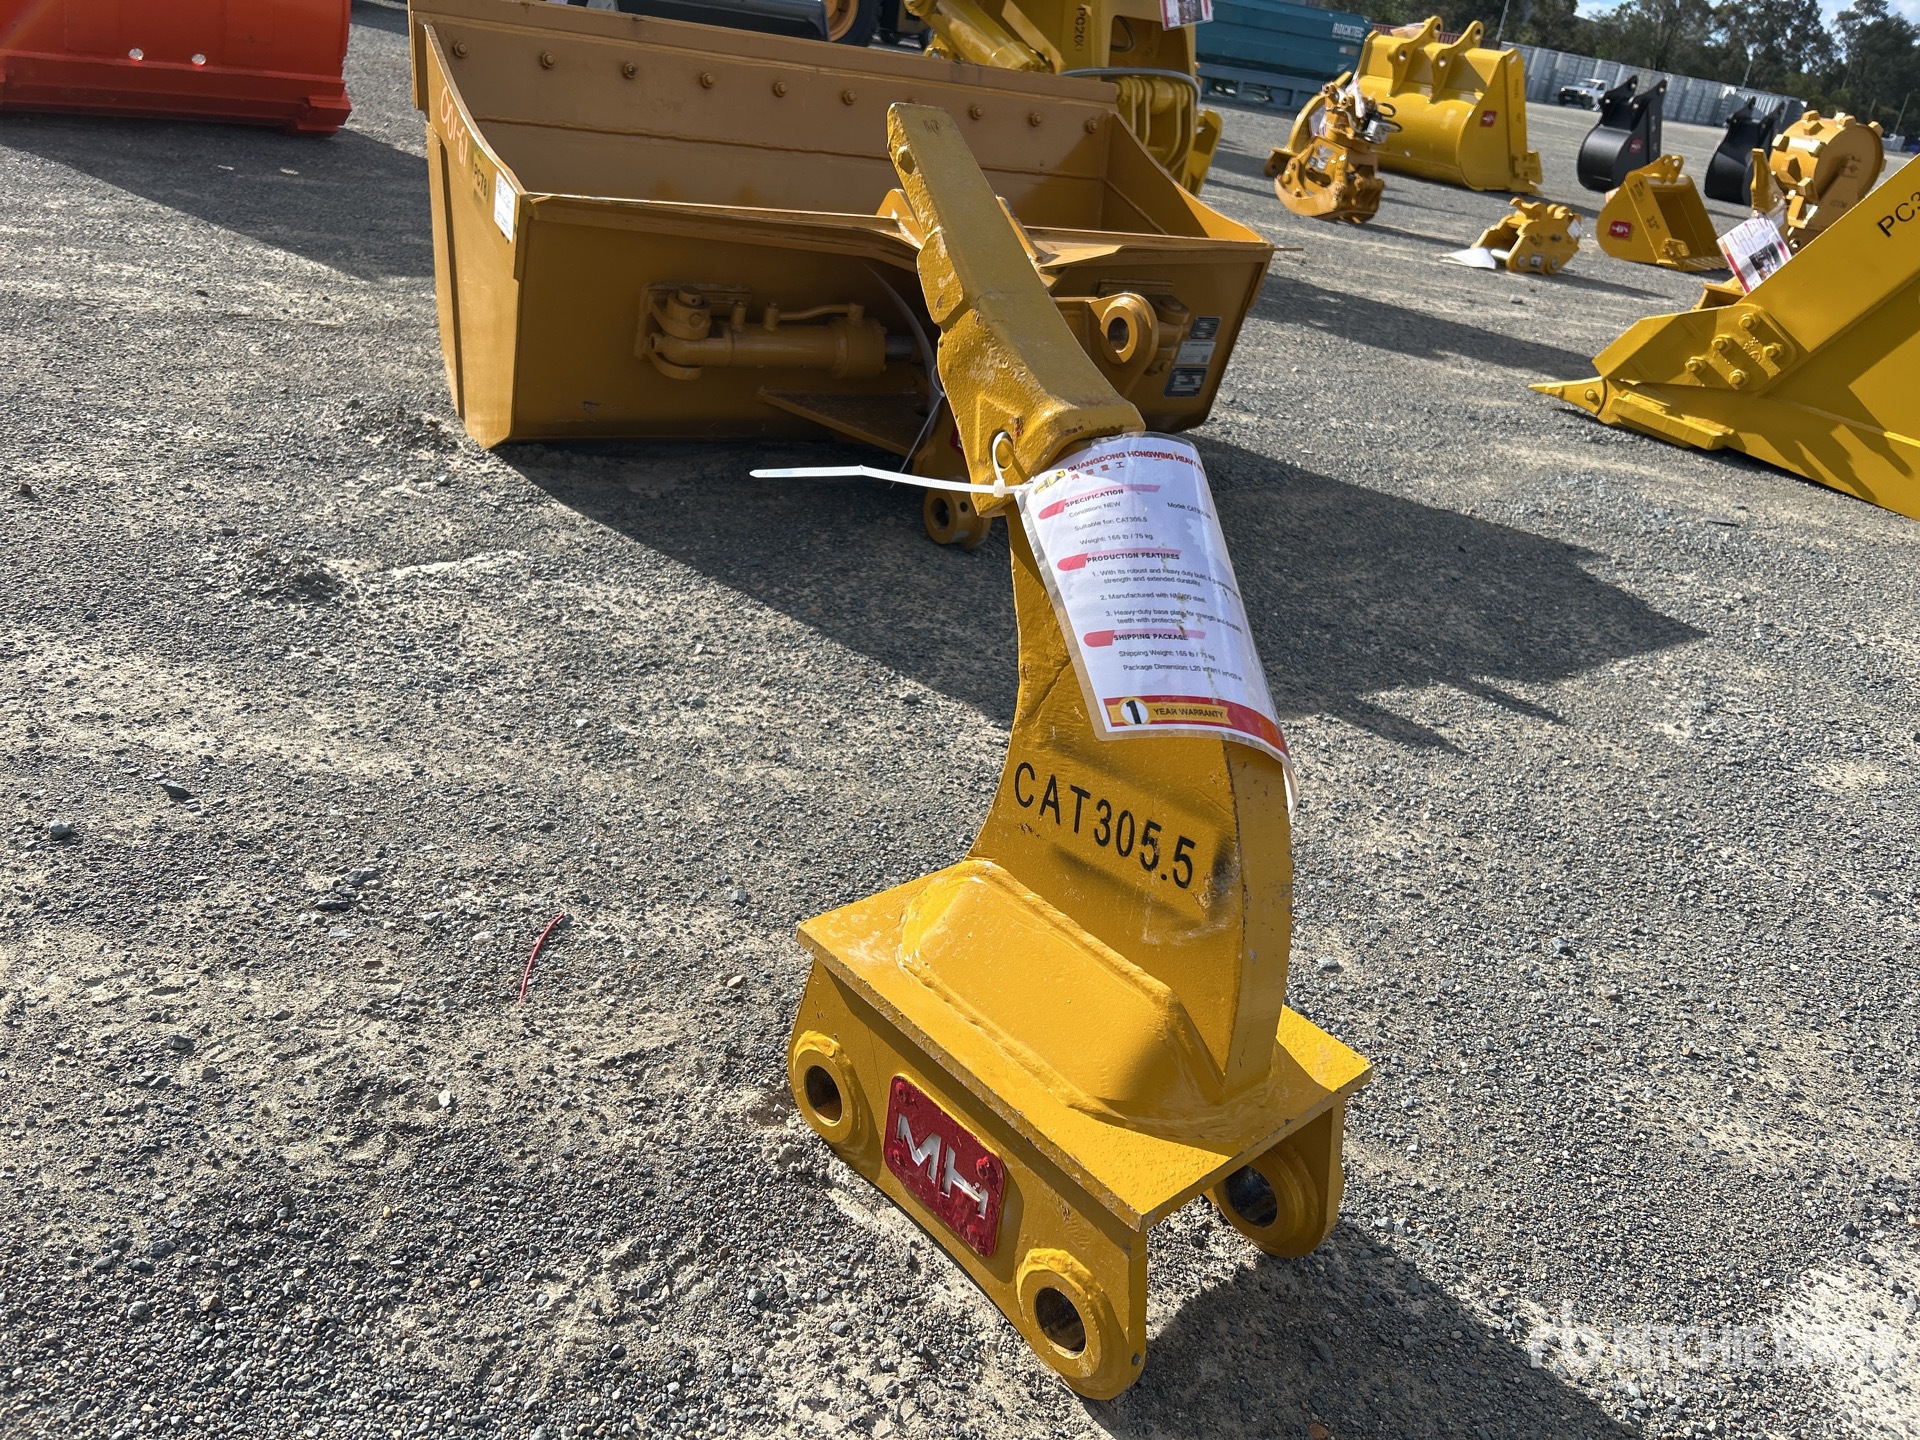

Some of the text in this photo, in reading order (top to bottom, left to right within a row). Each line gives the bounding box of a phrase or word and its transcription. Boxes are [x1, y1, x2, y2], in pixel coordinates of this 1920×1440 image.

[1068, 452, 1126, 472] GUANGDONG
[1065, 489, 1124, 507] SPECIFICATION
[1069, 501, 1121, 518] Condition: NEW
[1074, 520, 1101, 531] Suitable
[1087, 552, 1180, 563] PRODUCTION FEATURES
[1108, 592, 1154, 600] Manufactured
[1113, 633, 1150, 641] SHIPPING
[1119, 650, 1148, 658] Shipping
[1149, 649, 1174, 657] Weight:
[1153, 663, 1188, 671] Dimension:
[1126, 700, 1223, 725] 1 YEAR WARRANTY
[1014, 762, 1196, 889] CAT305.5
